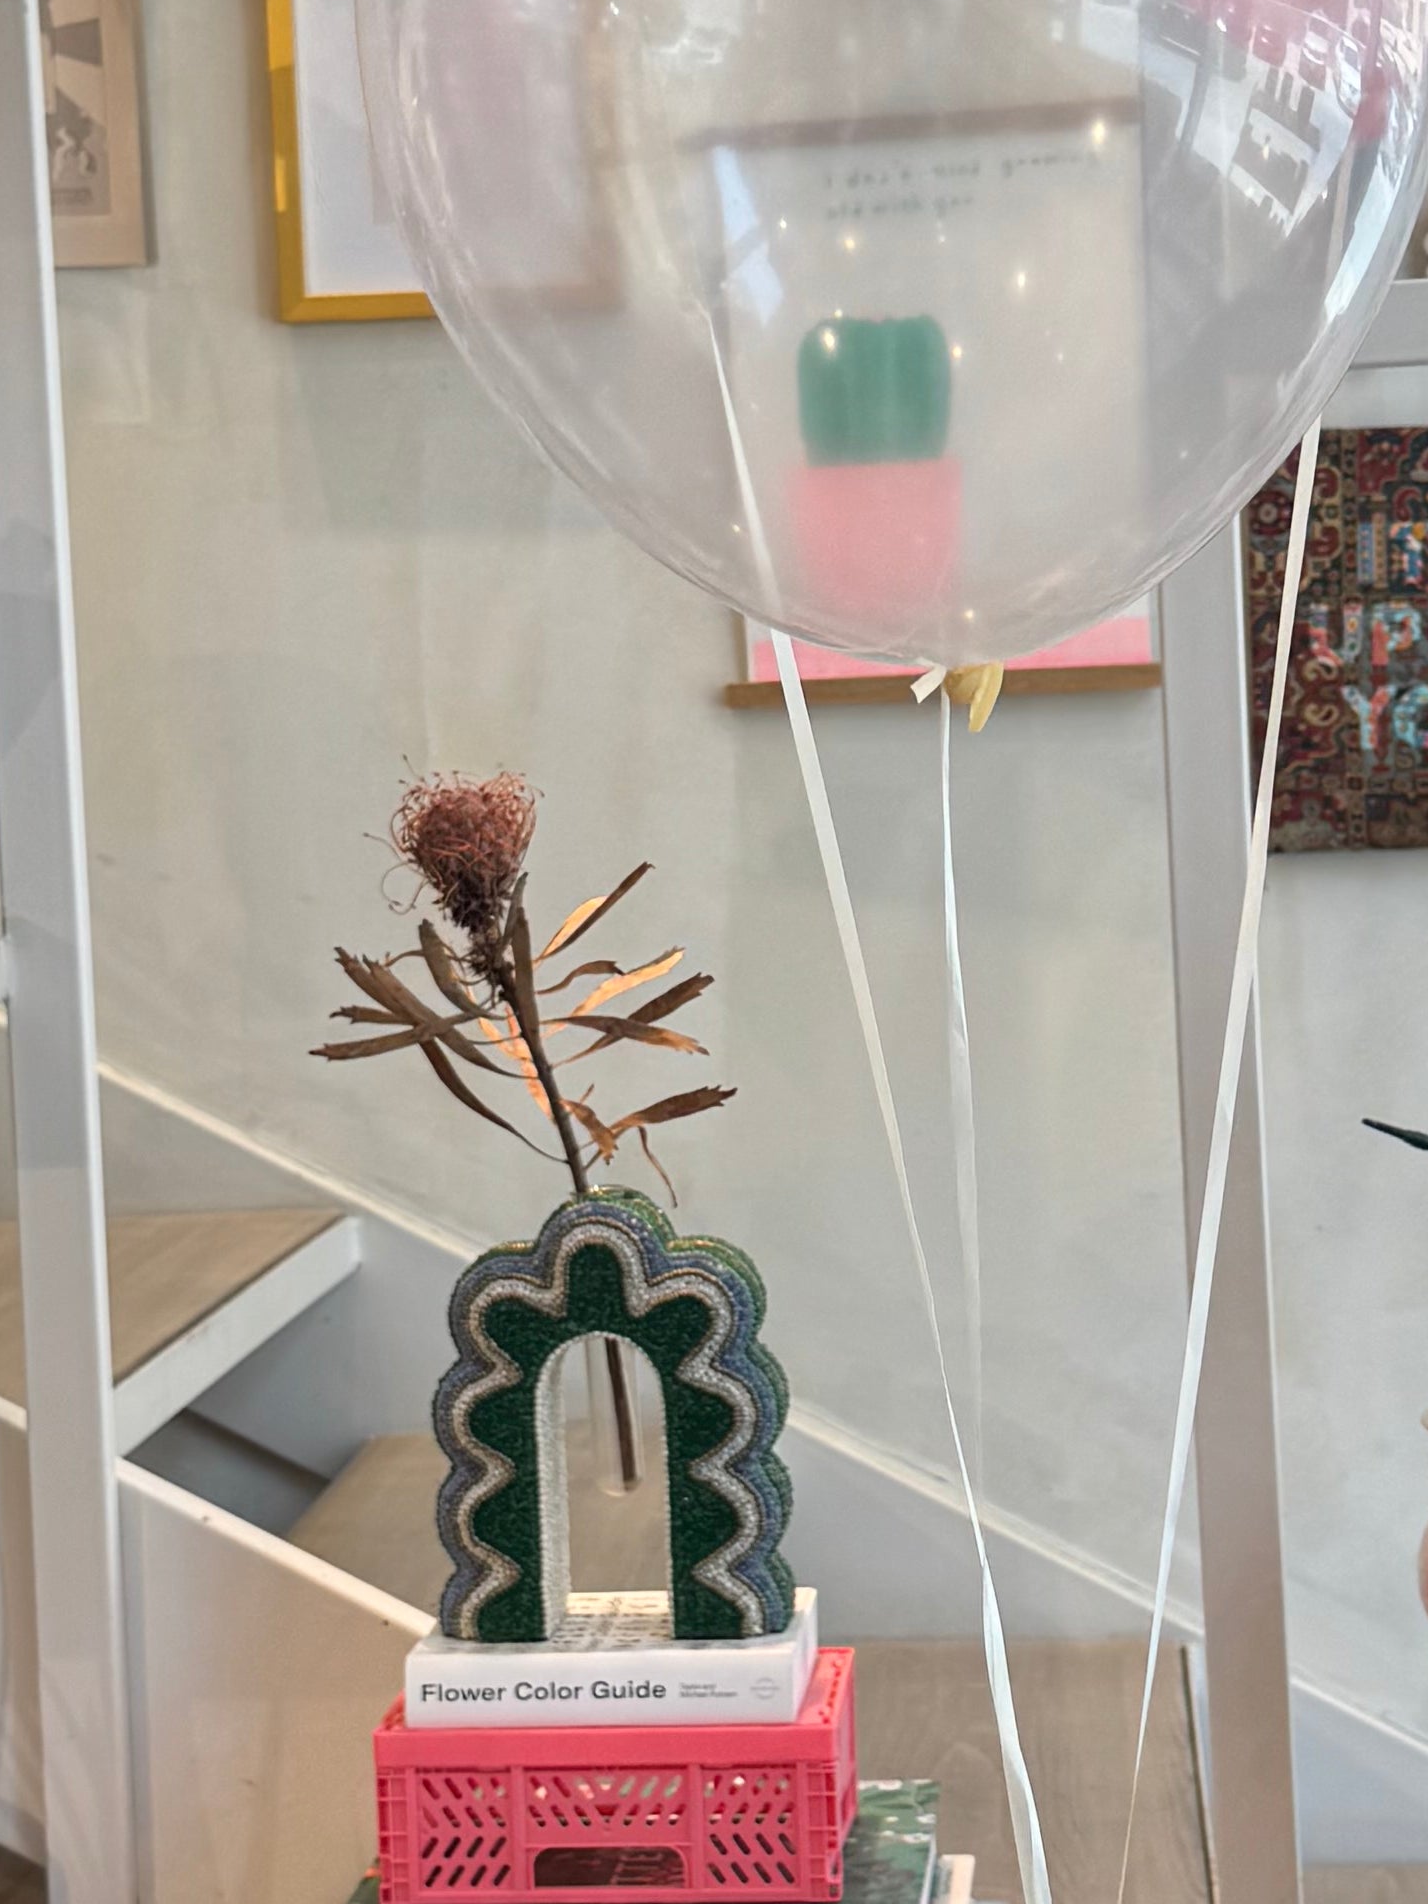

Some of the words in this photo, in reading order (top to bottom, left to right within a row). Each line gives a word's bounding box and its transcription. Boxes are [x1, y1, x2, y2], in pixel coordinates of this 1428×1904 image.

[421, 1682, 507, 1703] Flower
[513, 1681, 584, 1702] Color
[591, 1680, 667, 1700] Guide
